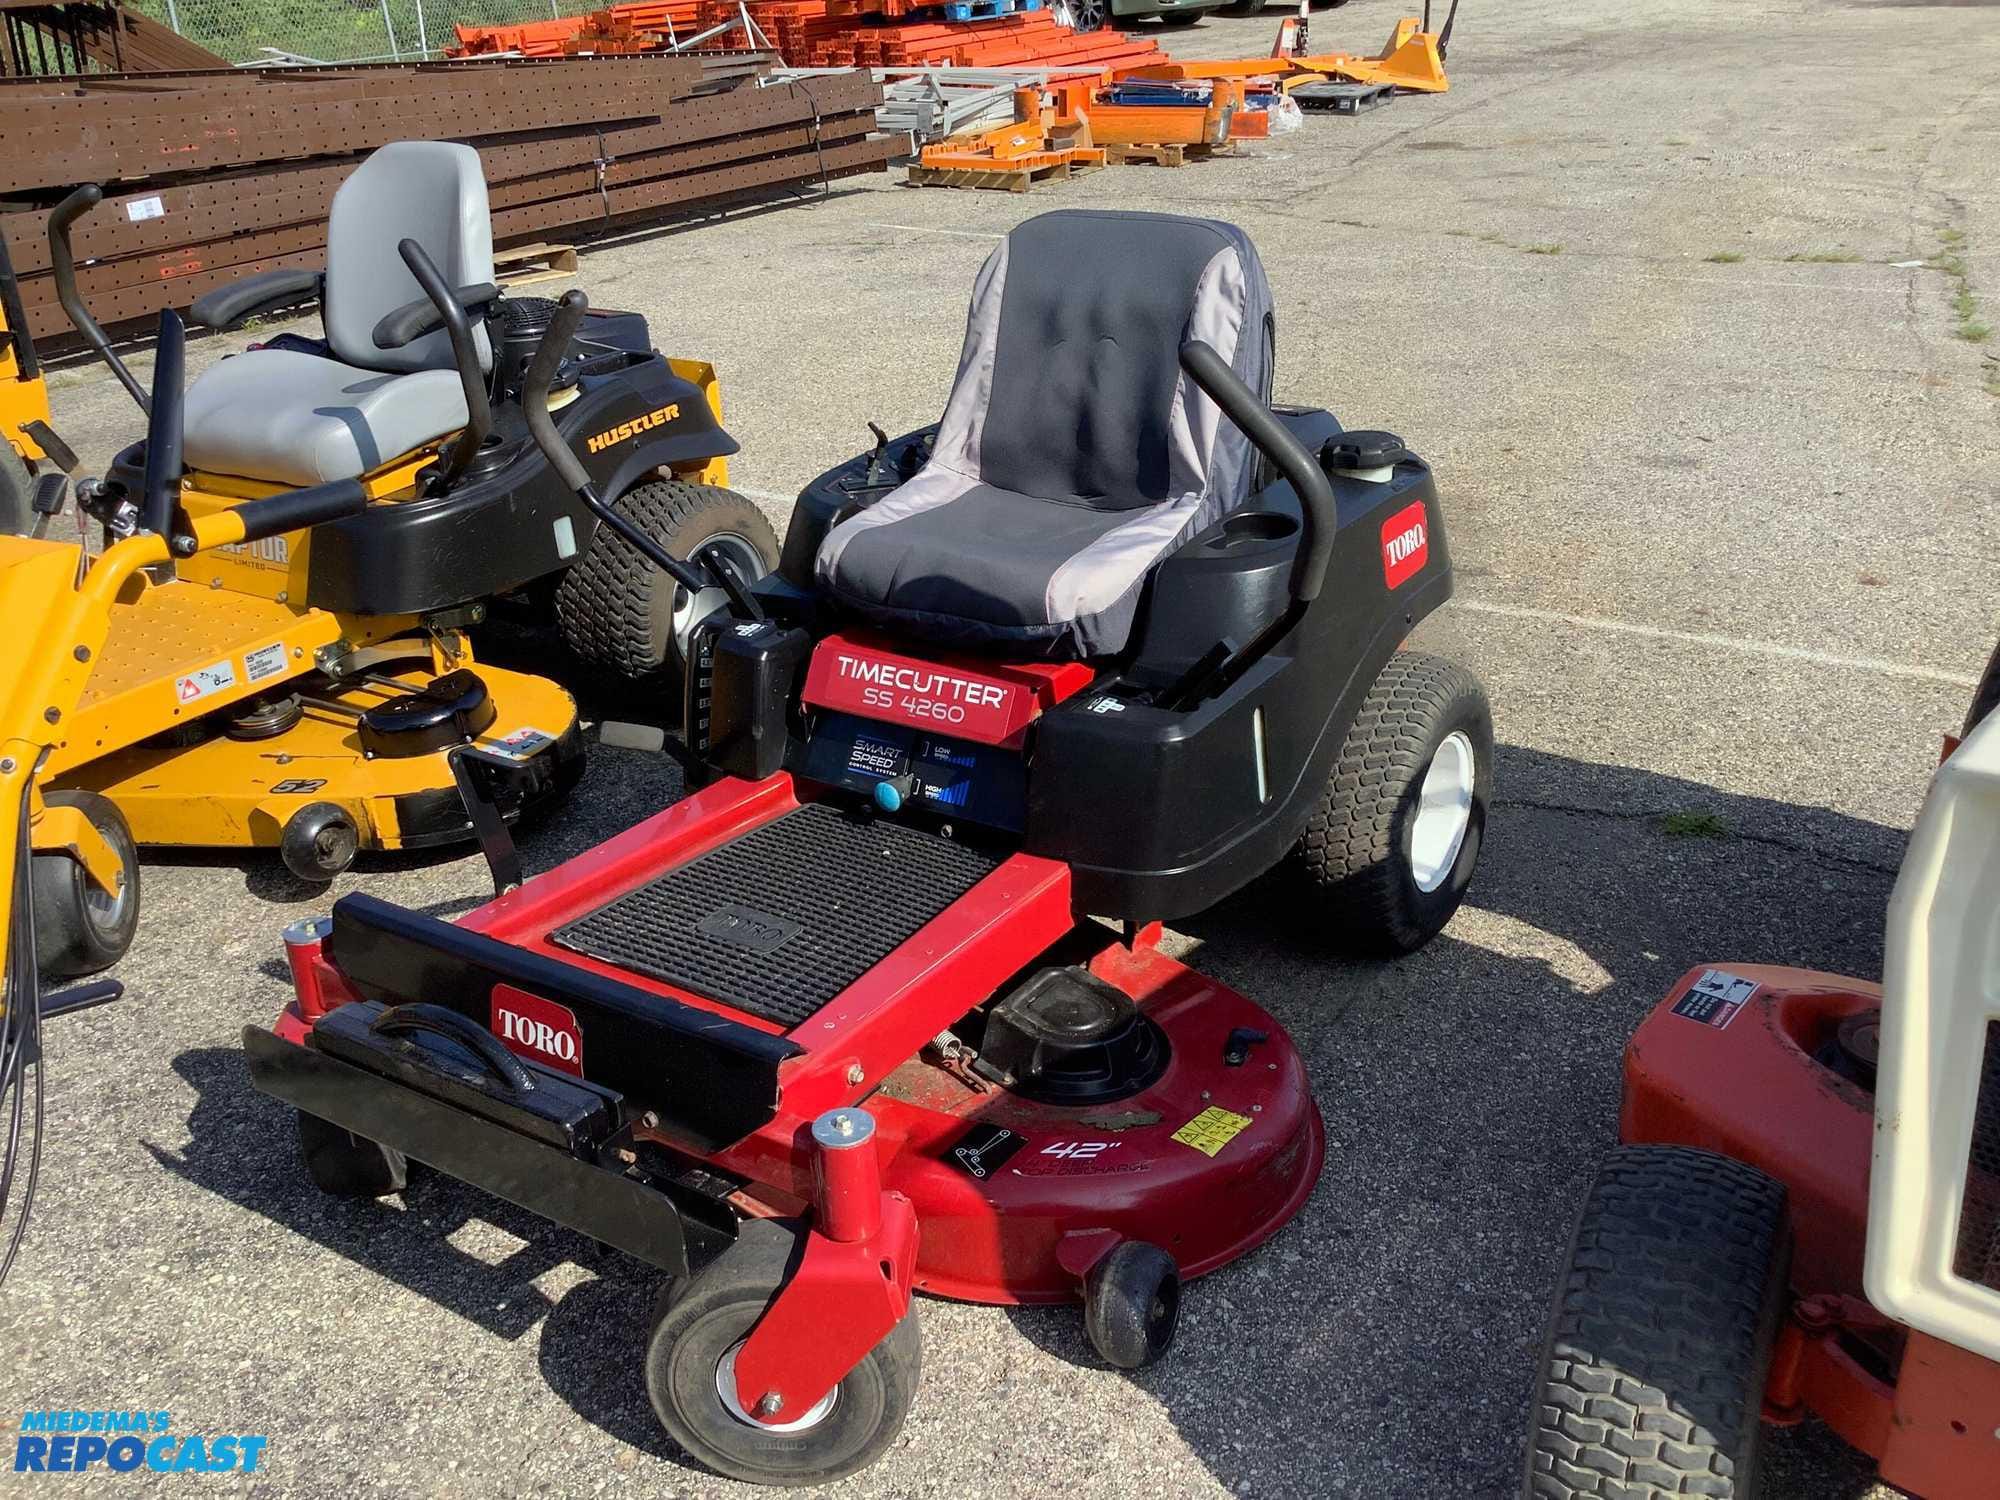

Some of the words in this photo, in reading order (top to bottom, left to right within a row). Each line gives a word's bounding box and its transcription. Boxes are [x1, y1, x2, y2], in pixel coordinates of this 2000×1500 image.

[587, 403, 680, 454] HUSTLER
[1386, 523, 1424, 567] TORO
[838, 656, 1002, 709] TIMECUTTER
[862, 687, 894, 708] SS
[900, 695, 965, 723] 4260
[853, 740, 903, 758] SMART
[934, 746, 951, 755] LOW
[851, 750, 893, 768] SPEED
[848, 761, 873, 771] CONTROL
[875, 767, 897, 776] SYSTEM
[271, 780, 326, 793] 52
[925, 784, 942, 793] HIGH
[498, 1008, 575, 1060] TORO
[1040, 1141, 1122, 1159] 42"
